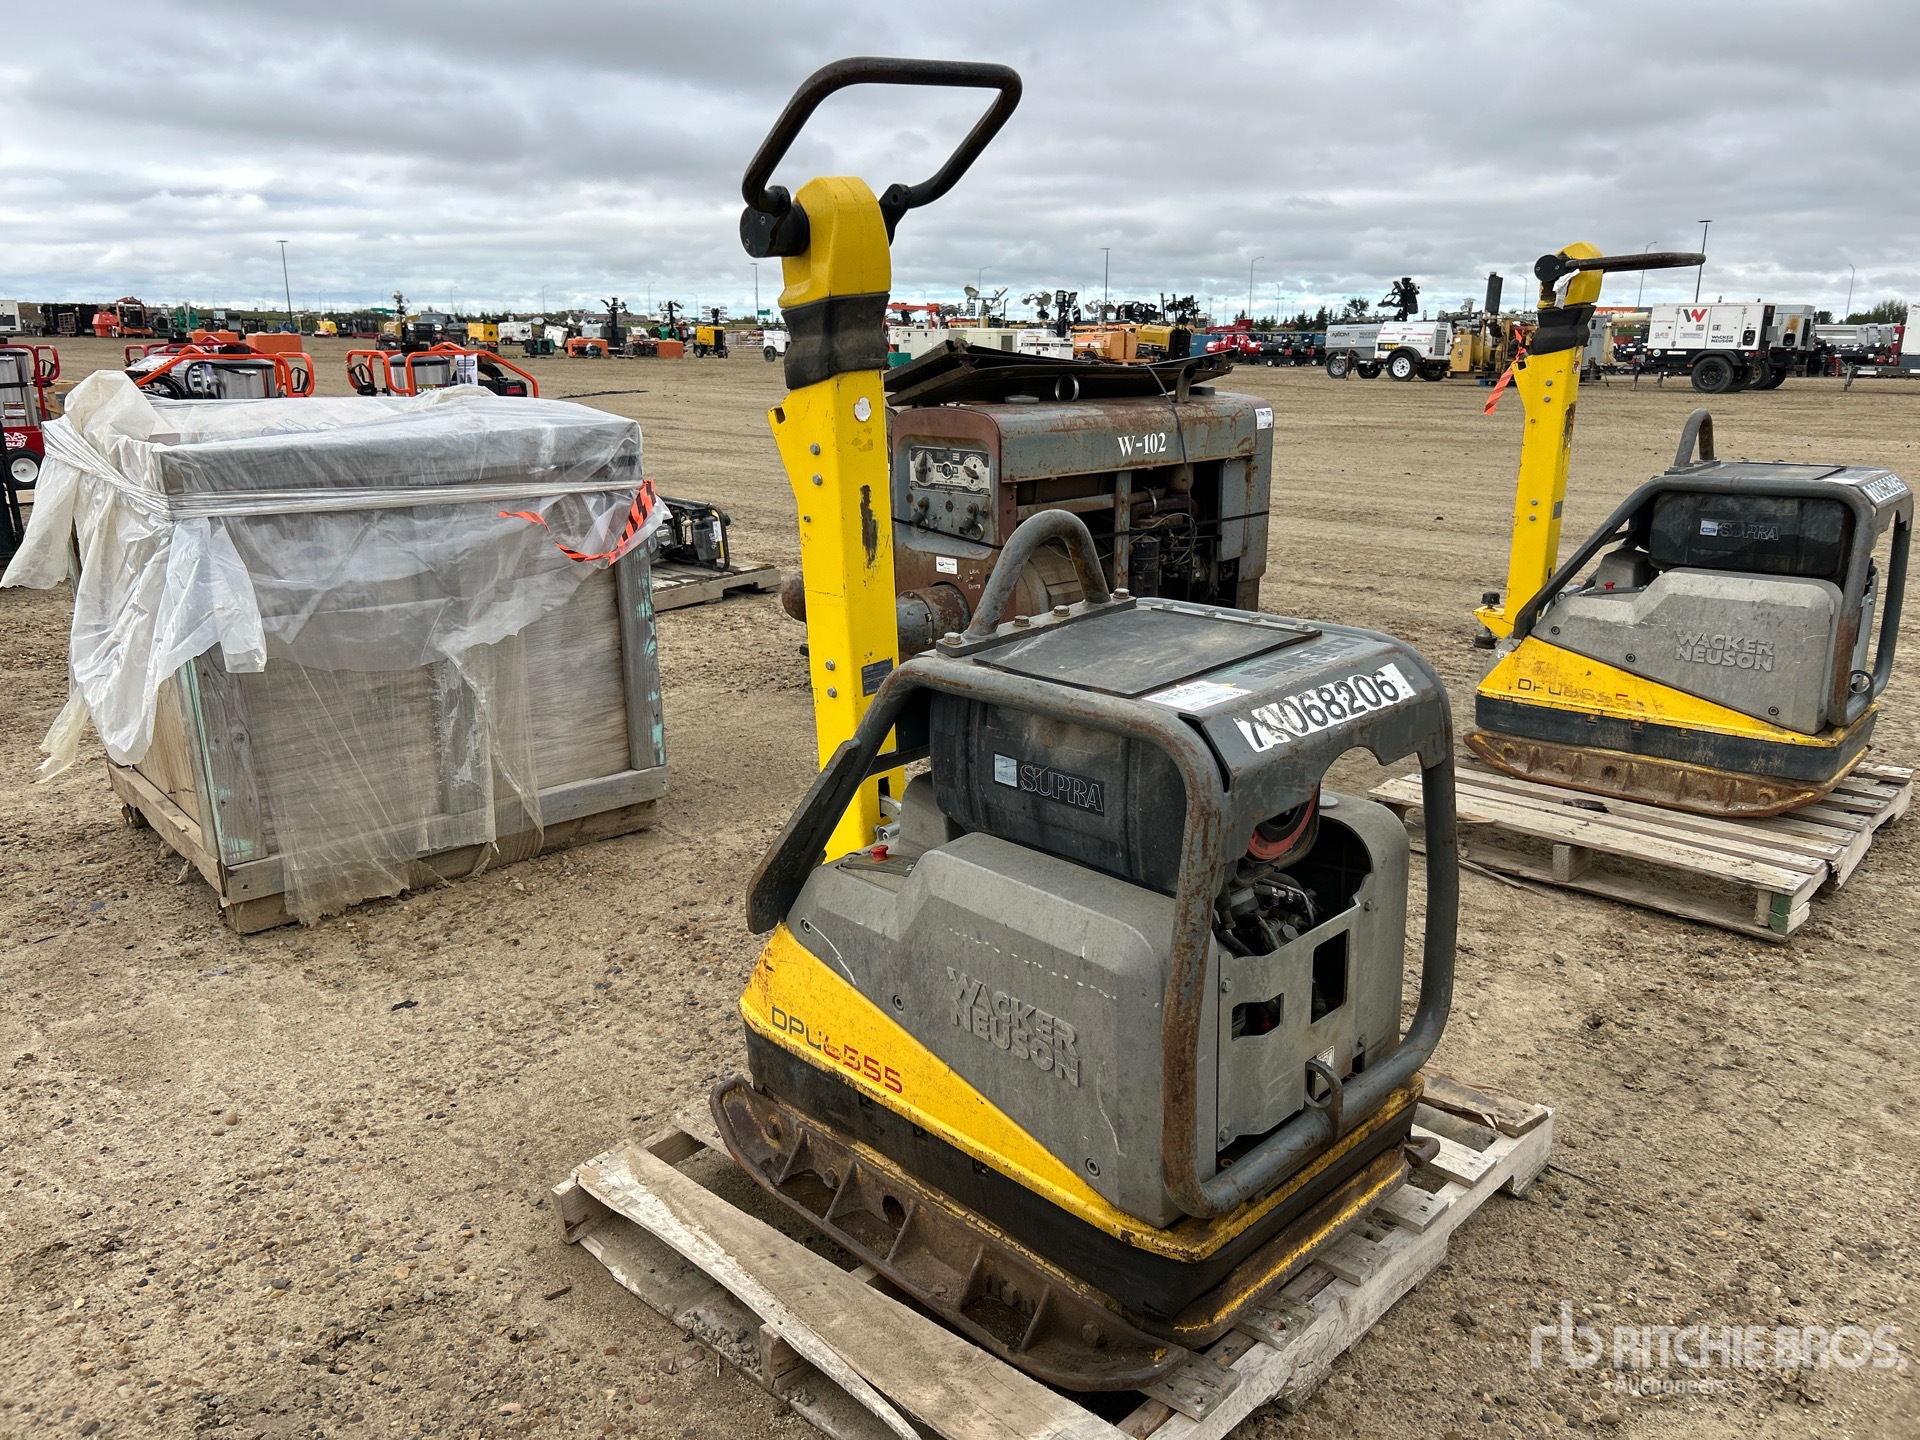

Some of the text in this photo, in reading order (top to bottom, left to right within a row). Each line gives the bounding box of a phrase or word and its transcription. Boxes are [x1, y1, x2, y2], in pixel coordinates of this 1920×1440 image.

[1117, 432, 1167, 457] W-102
[1675, 631, 1774, 656] WACKER
[1675, 645, 1773, 672] NEUSON
[1020, 764, 1104, 812] SUPRA
[947, 966, 1081, 1060] WACKER
[952, 996, 1081, 1088] NEUSON
